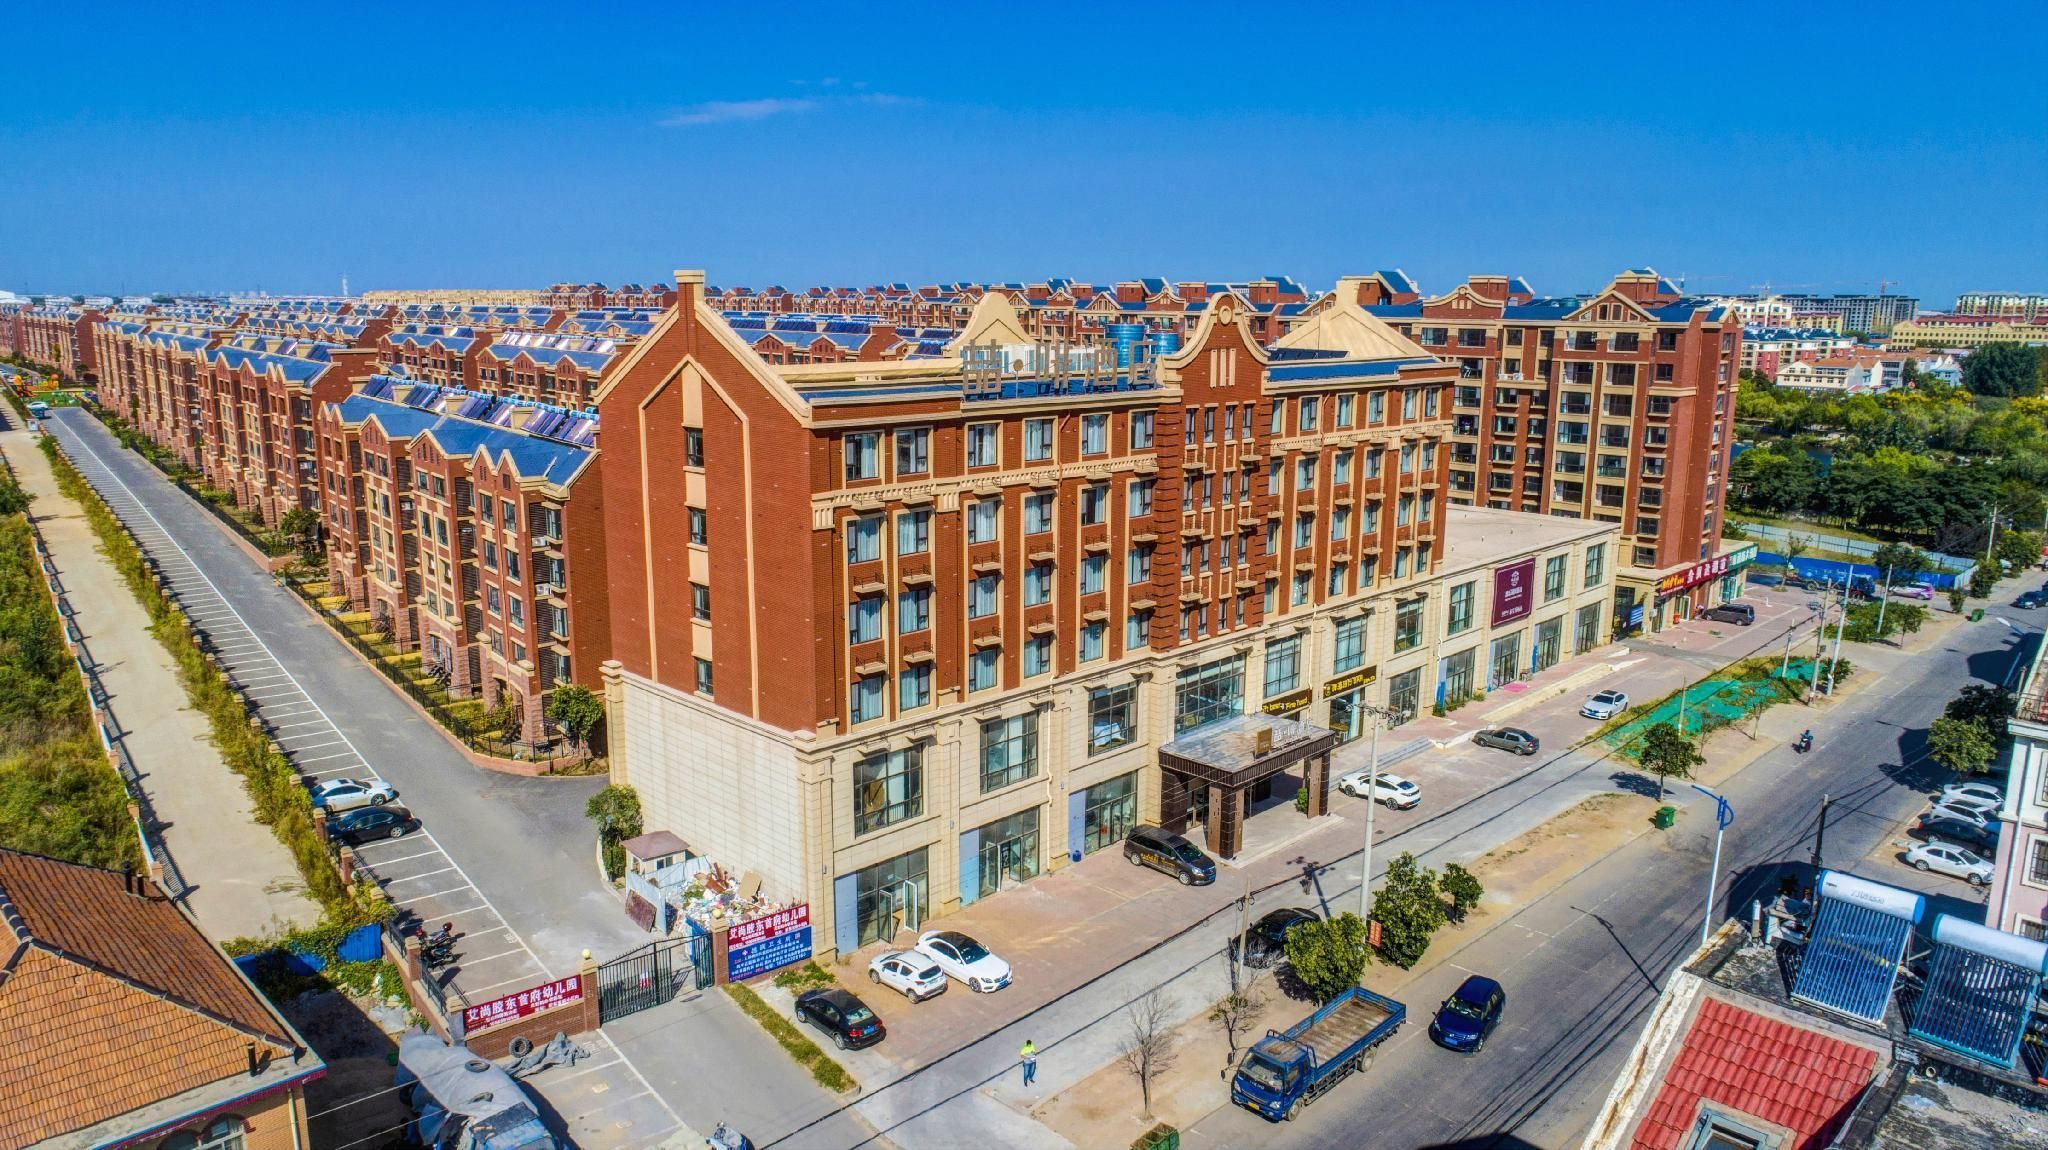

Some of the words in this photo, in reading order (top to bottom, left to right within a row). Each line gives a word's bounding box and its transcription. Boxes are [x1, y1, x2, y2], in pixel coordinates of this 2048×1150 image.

[466, 977, 578, 1023] 艾尚胶东首府幼儿园
